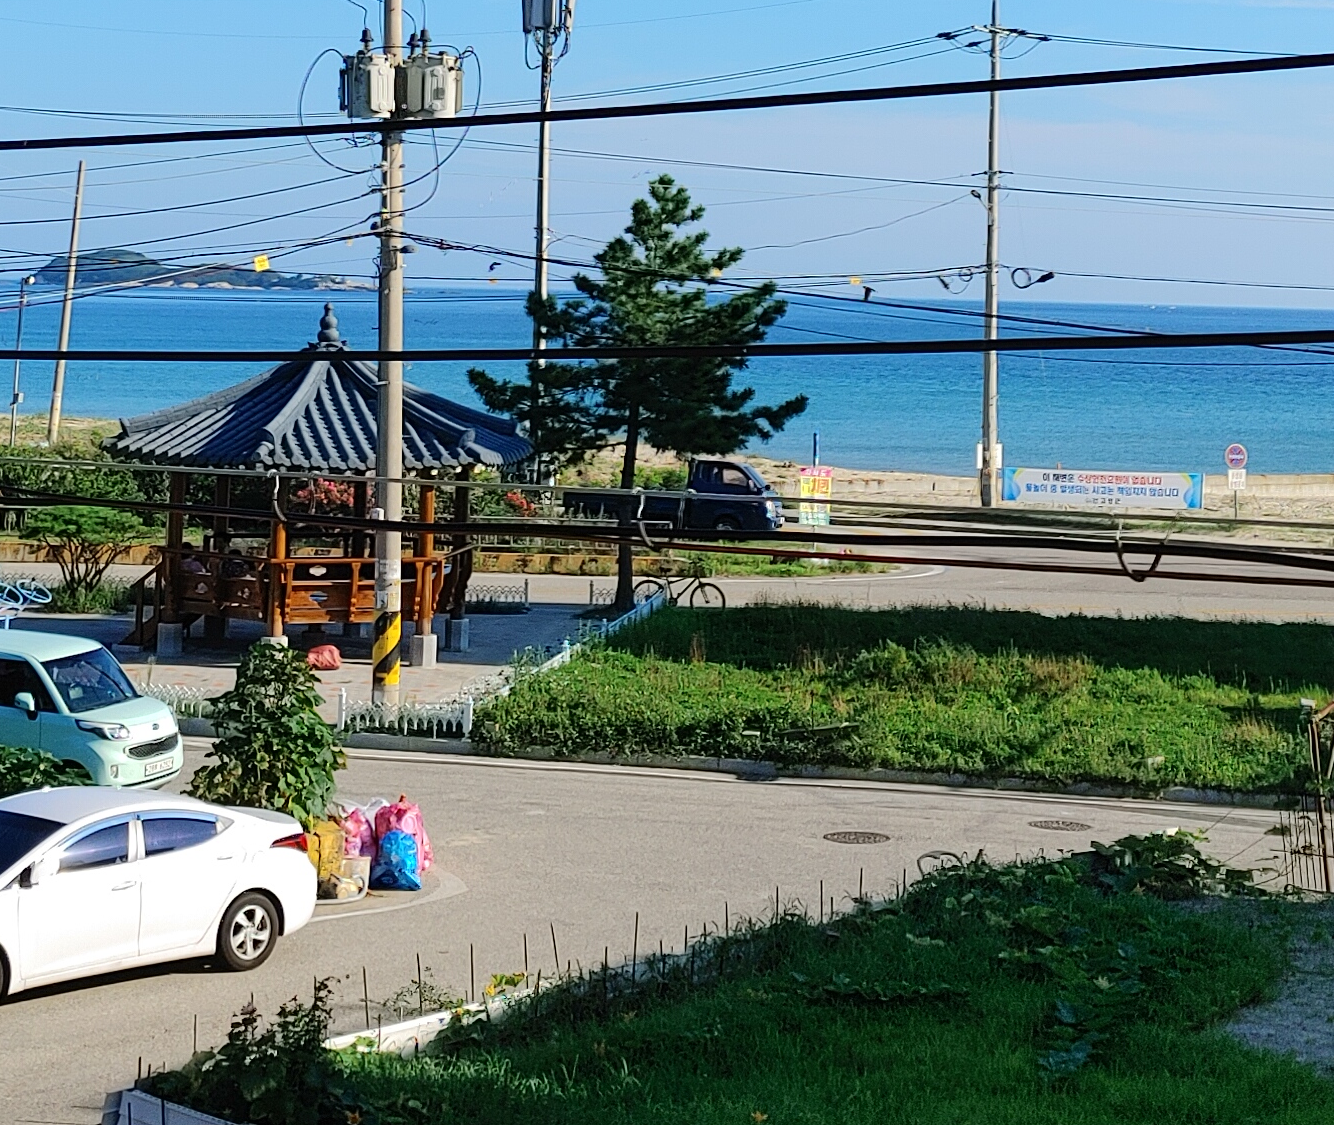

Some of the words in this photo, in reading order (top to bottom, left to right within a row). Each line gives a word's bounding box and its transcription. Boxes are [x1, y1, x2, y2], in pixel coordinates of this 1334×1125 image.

[1042, 473, 1050, 482] 이
[1053, 473, 1075, 484] 해변은
[1132, 476, 1162, 486] 없습니다
[1025, 483, 1048, 493] 물놀이
[1050, 484, 1058, 494] 중
[1092, 486, 1115, 496] 사고는
[1149, 488, 1179, 497] 않습니다
